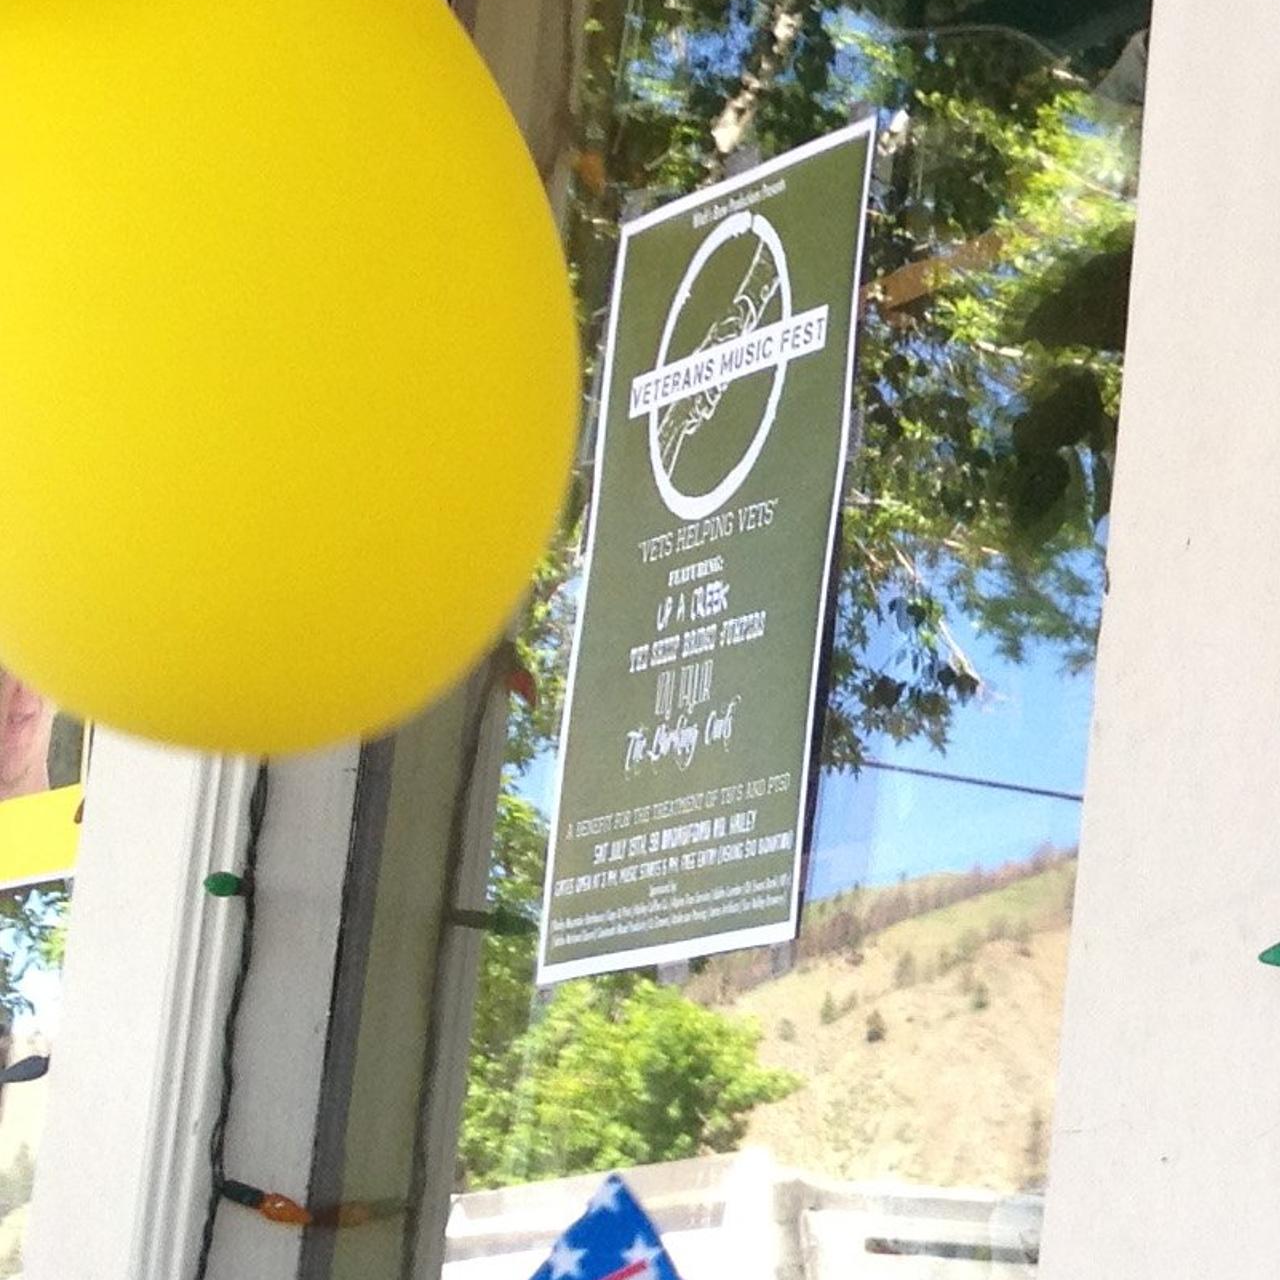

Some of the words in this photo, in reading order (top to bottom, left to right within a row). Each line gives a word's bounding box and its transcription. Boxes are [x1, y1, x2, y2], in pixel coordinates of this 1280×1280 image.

[633, 359, 714, 408] VETERANS
[721, 335, 773, 373] MUSIC
[780, 315, 825, 352] FEST
[676, 513, 732, 552] HELPING
[656, 597, 672, 630] UP
[677, 593, 686, 622] A
[691, 579, 729, 619] CREEK
[575, 814, 611, 838] BENEFIT
[613, 810, 630, 829] FOR
[632, 806, 650, 825] THE
[652, 793, 703, 821] TREATMENT
[745, 779, 766, 799] AND
